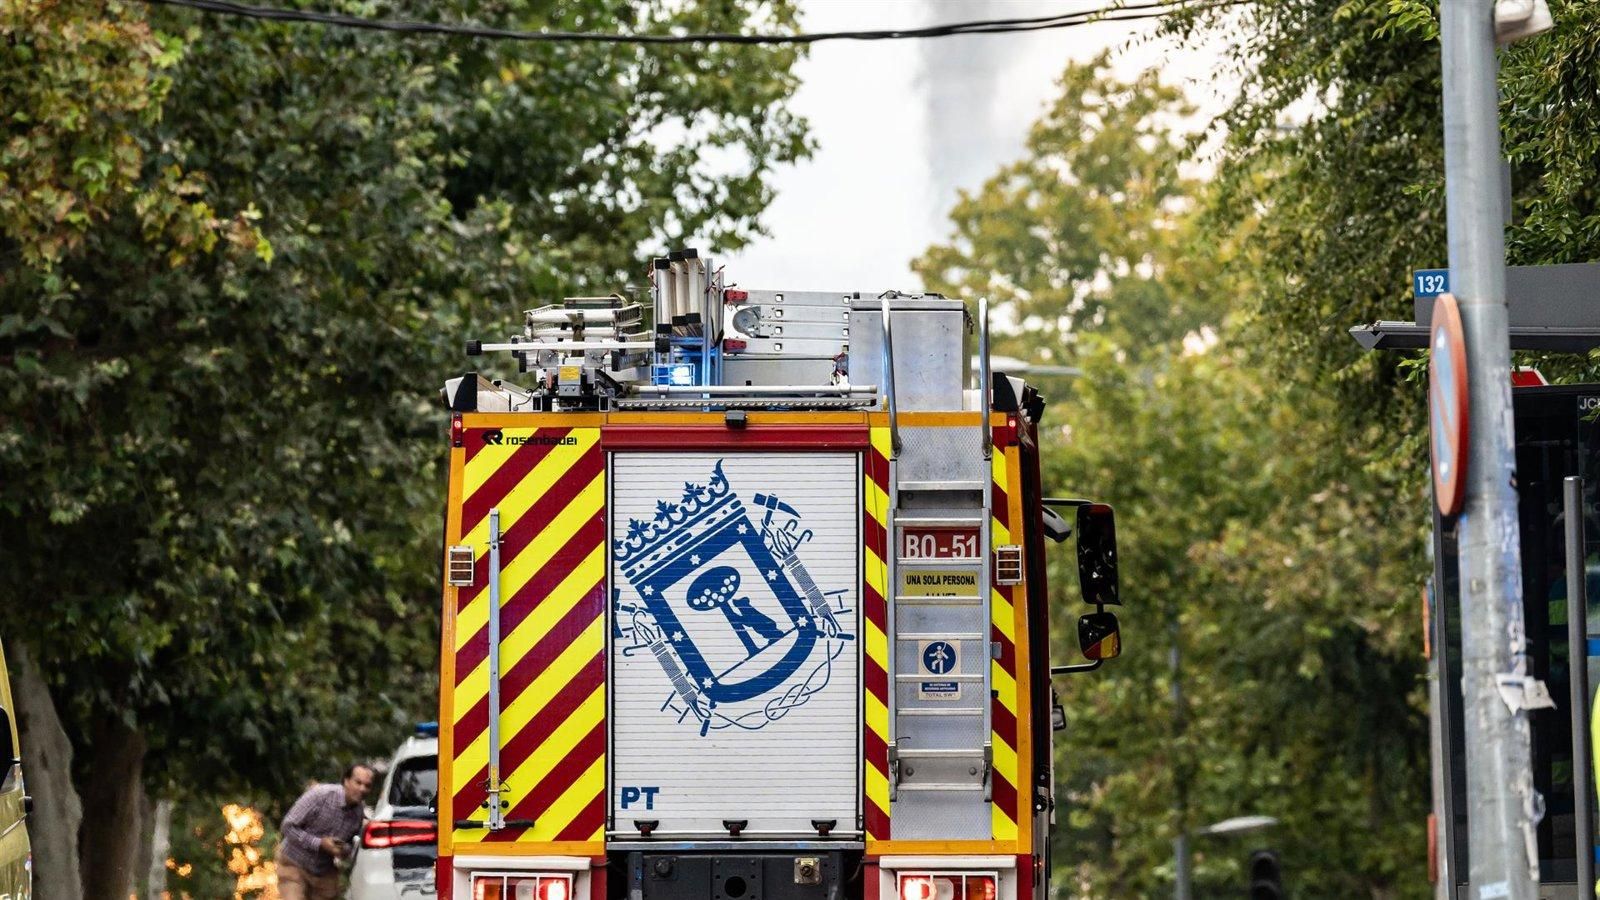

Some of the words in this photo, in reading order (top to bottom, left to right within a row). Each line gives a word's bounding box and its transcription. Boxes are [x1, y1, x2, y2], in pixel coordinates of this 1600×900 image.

[1417, 274, 1445, 293] 132
[1579, 397, 1600, 410] JC
[905, 534, 977, 558] BO-51
[906, 575, 921, 585] UNA
[923, 575, 941, 585] SOLA
[943, 575, 975, 585] PERSONA
[621, 786, 659, 810] PT
